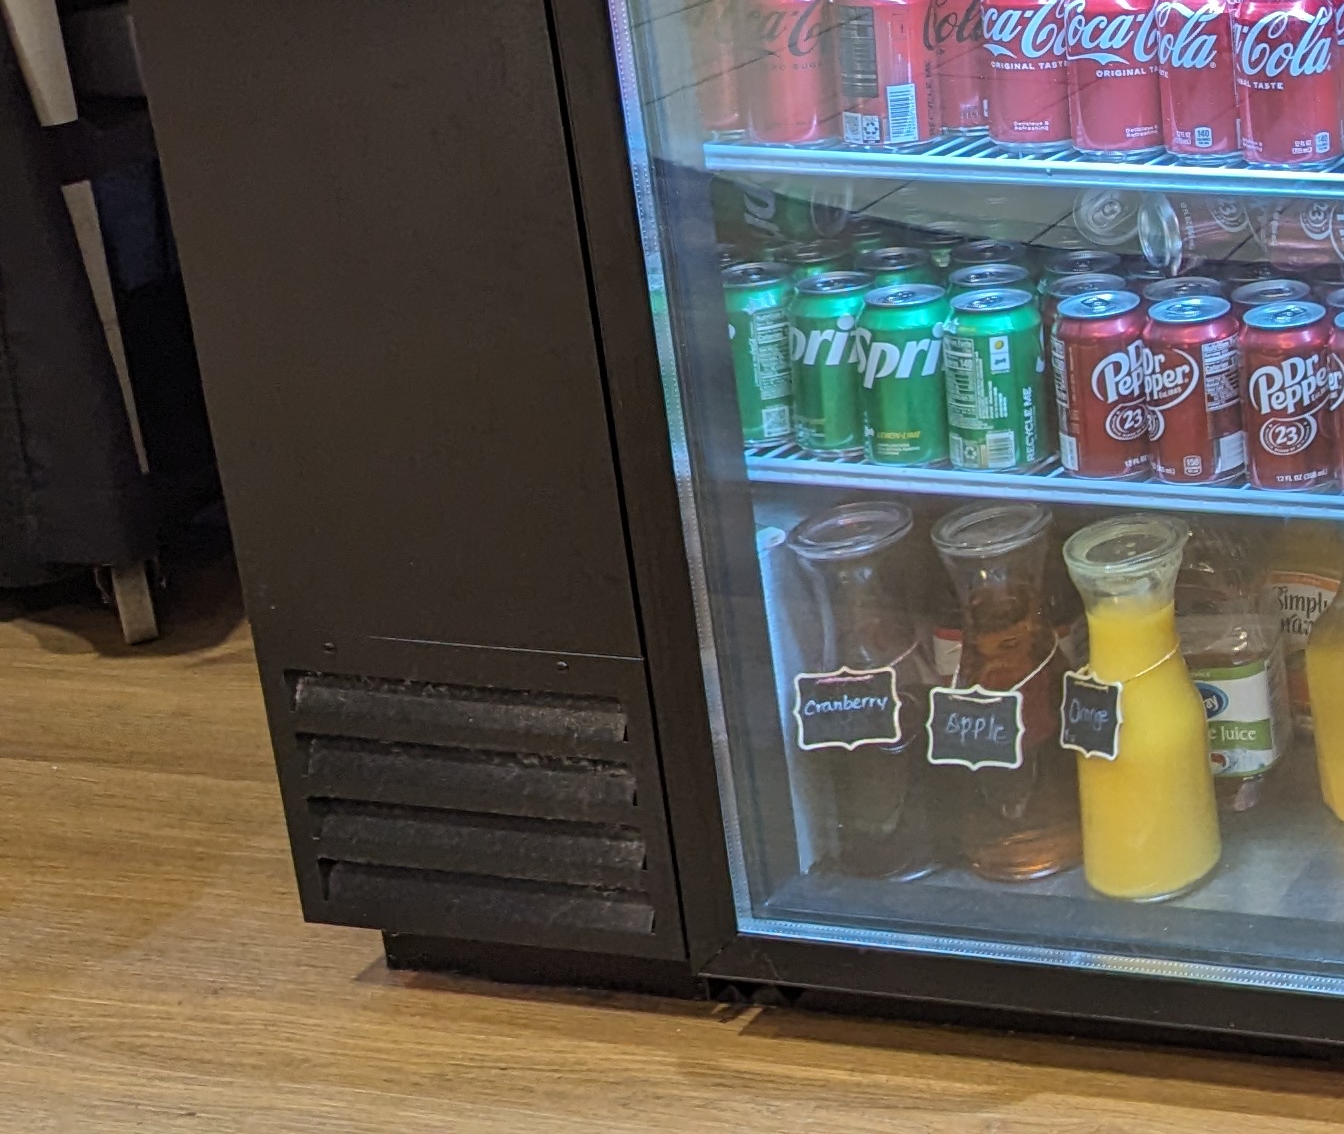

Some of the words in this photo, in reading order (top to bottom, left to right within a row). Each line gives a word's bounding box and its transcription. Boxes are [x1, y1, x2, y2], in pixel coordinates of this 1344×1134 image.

[1095, 68, 1147, 78] ORIGINAL
[1253, 80, 1285, 91] TASTE
[1196, 129, 1211, 139] 140
[1280, 356, 1319, 387] Dr
[1023, 386, 1033, 407] ME
[1124, 413, 1144, 430] 23
[1022, 409, 1035, 463] RECYCLE
[1273, 425, 1300, 446] 23
[804, 695, 889, 717] Cranberry
[1221, 725, 1257, 741] Juice
